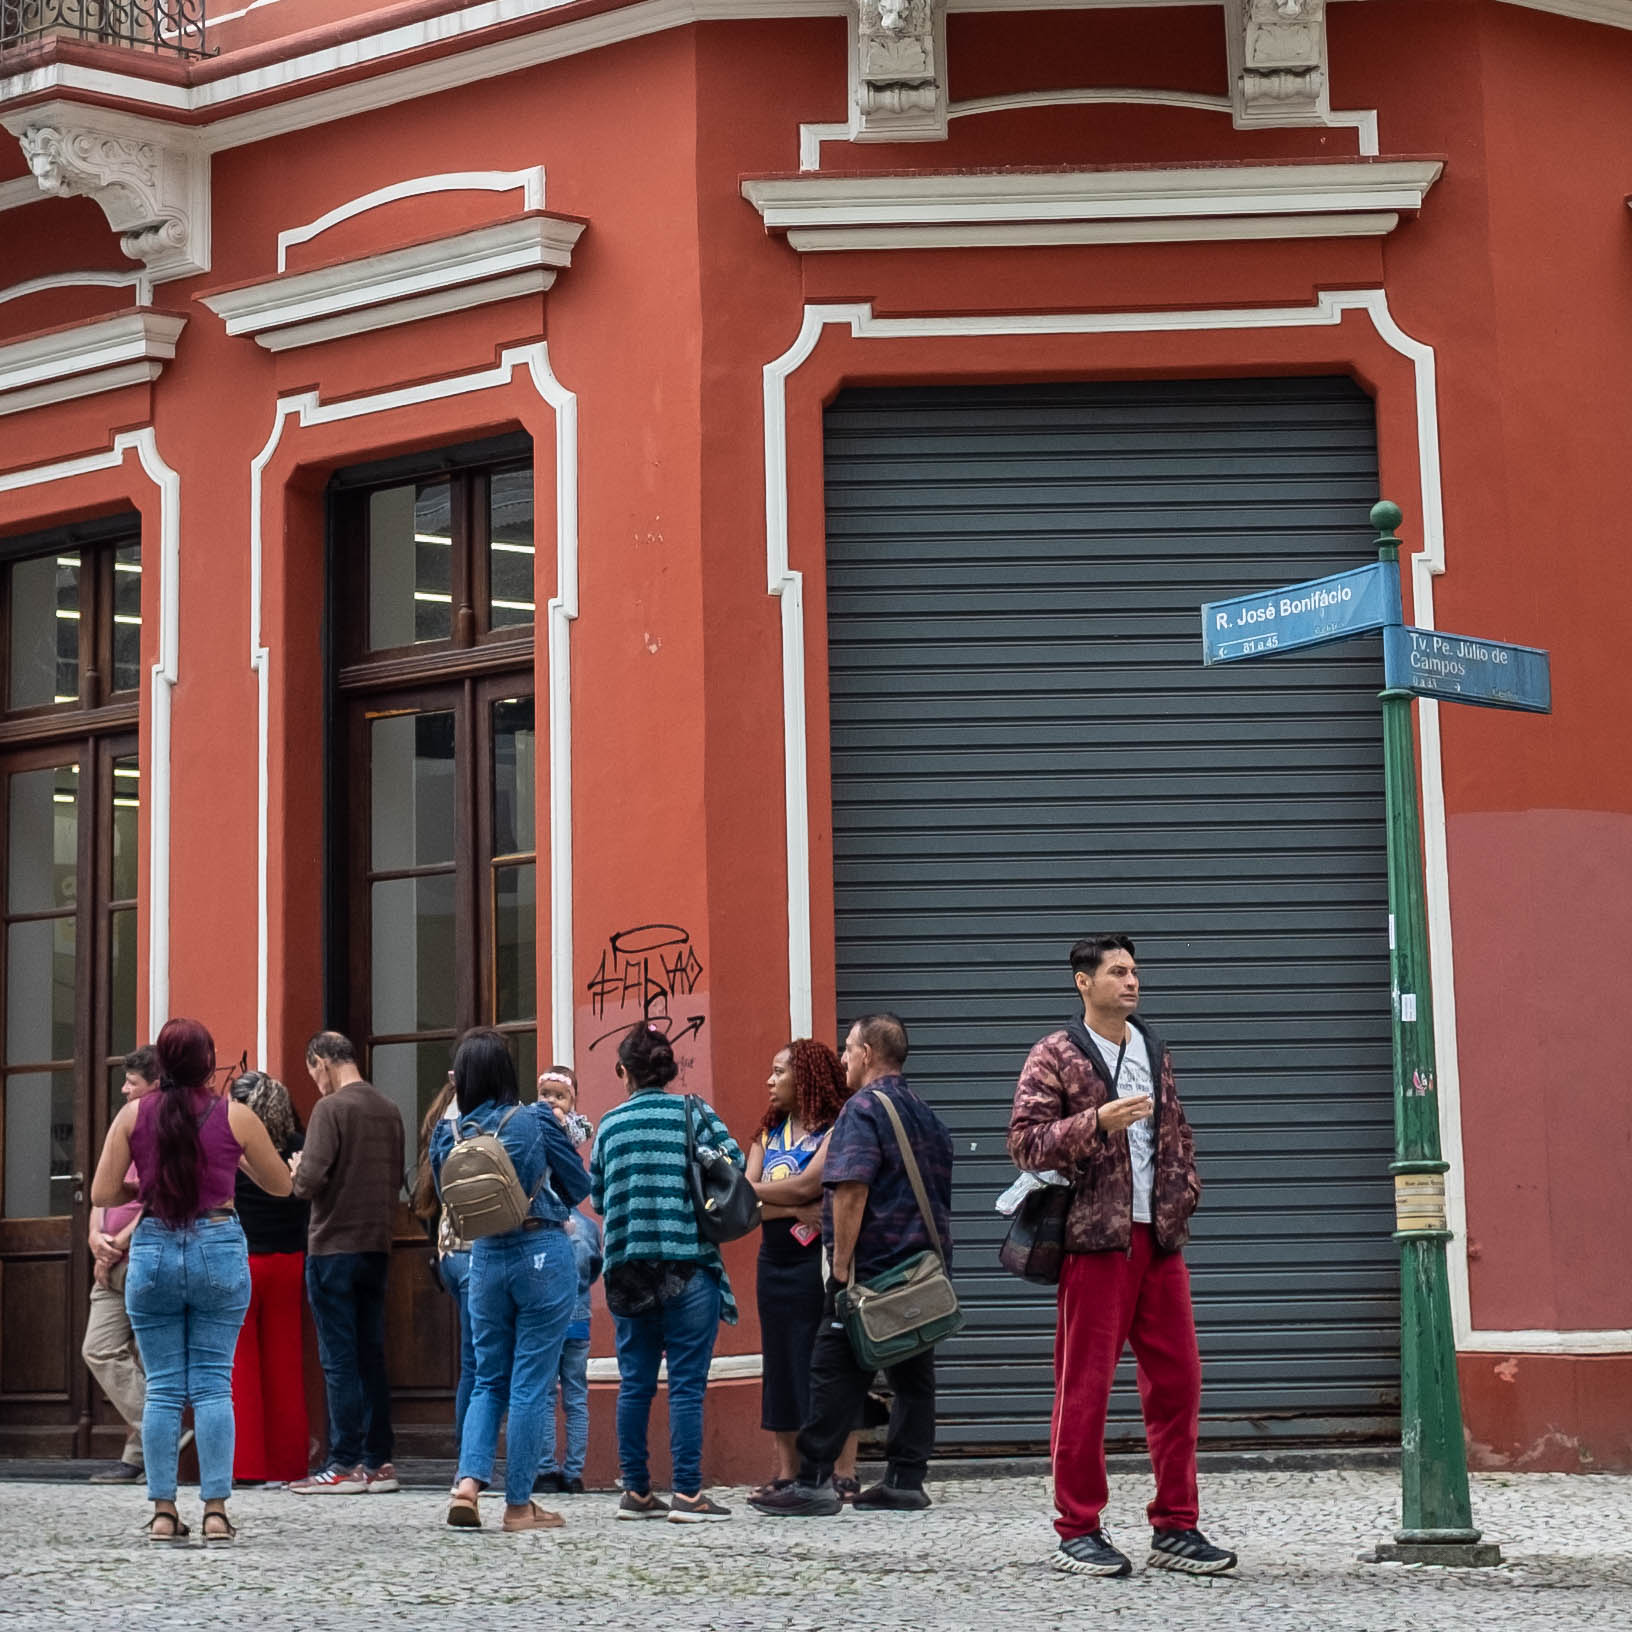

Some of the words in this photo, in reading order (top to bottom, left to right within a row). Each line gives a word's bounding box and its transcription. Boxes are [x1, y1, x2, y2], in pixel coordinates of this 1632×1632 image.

[1216, 612, 1233, 631] R.
[1237, 602, 1276, 626] José
[1280, 584, 1352, 617] Bonifácio
[1409, 632, 1430, 653] Tv.
[1433, 636, 1453, 656] Pe.
[1456, 641, 1488, 662] Júlio
[1491, 647, 1509, 665] de
[1410, 650, 1466, 676] Campos
